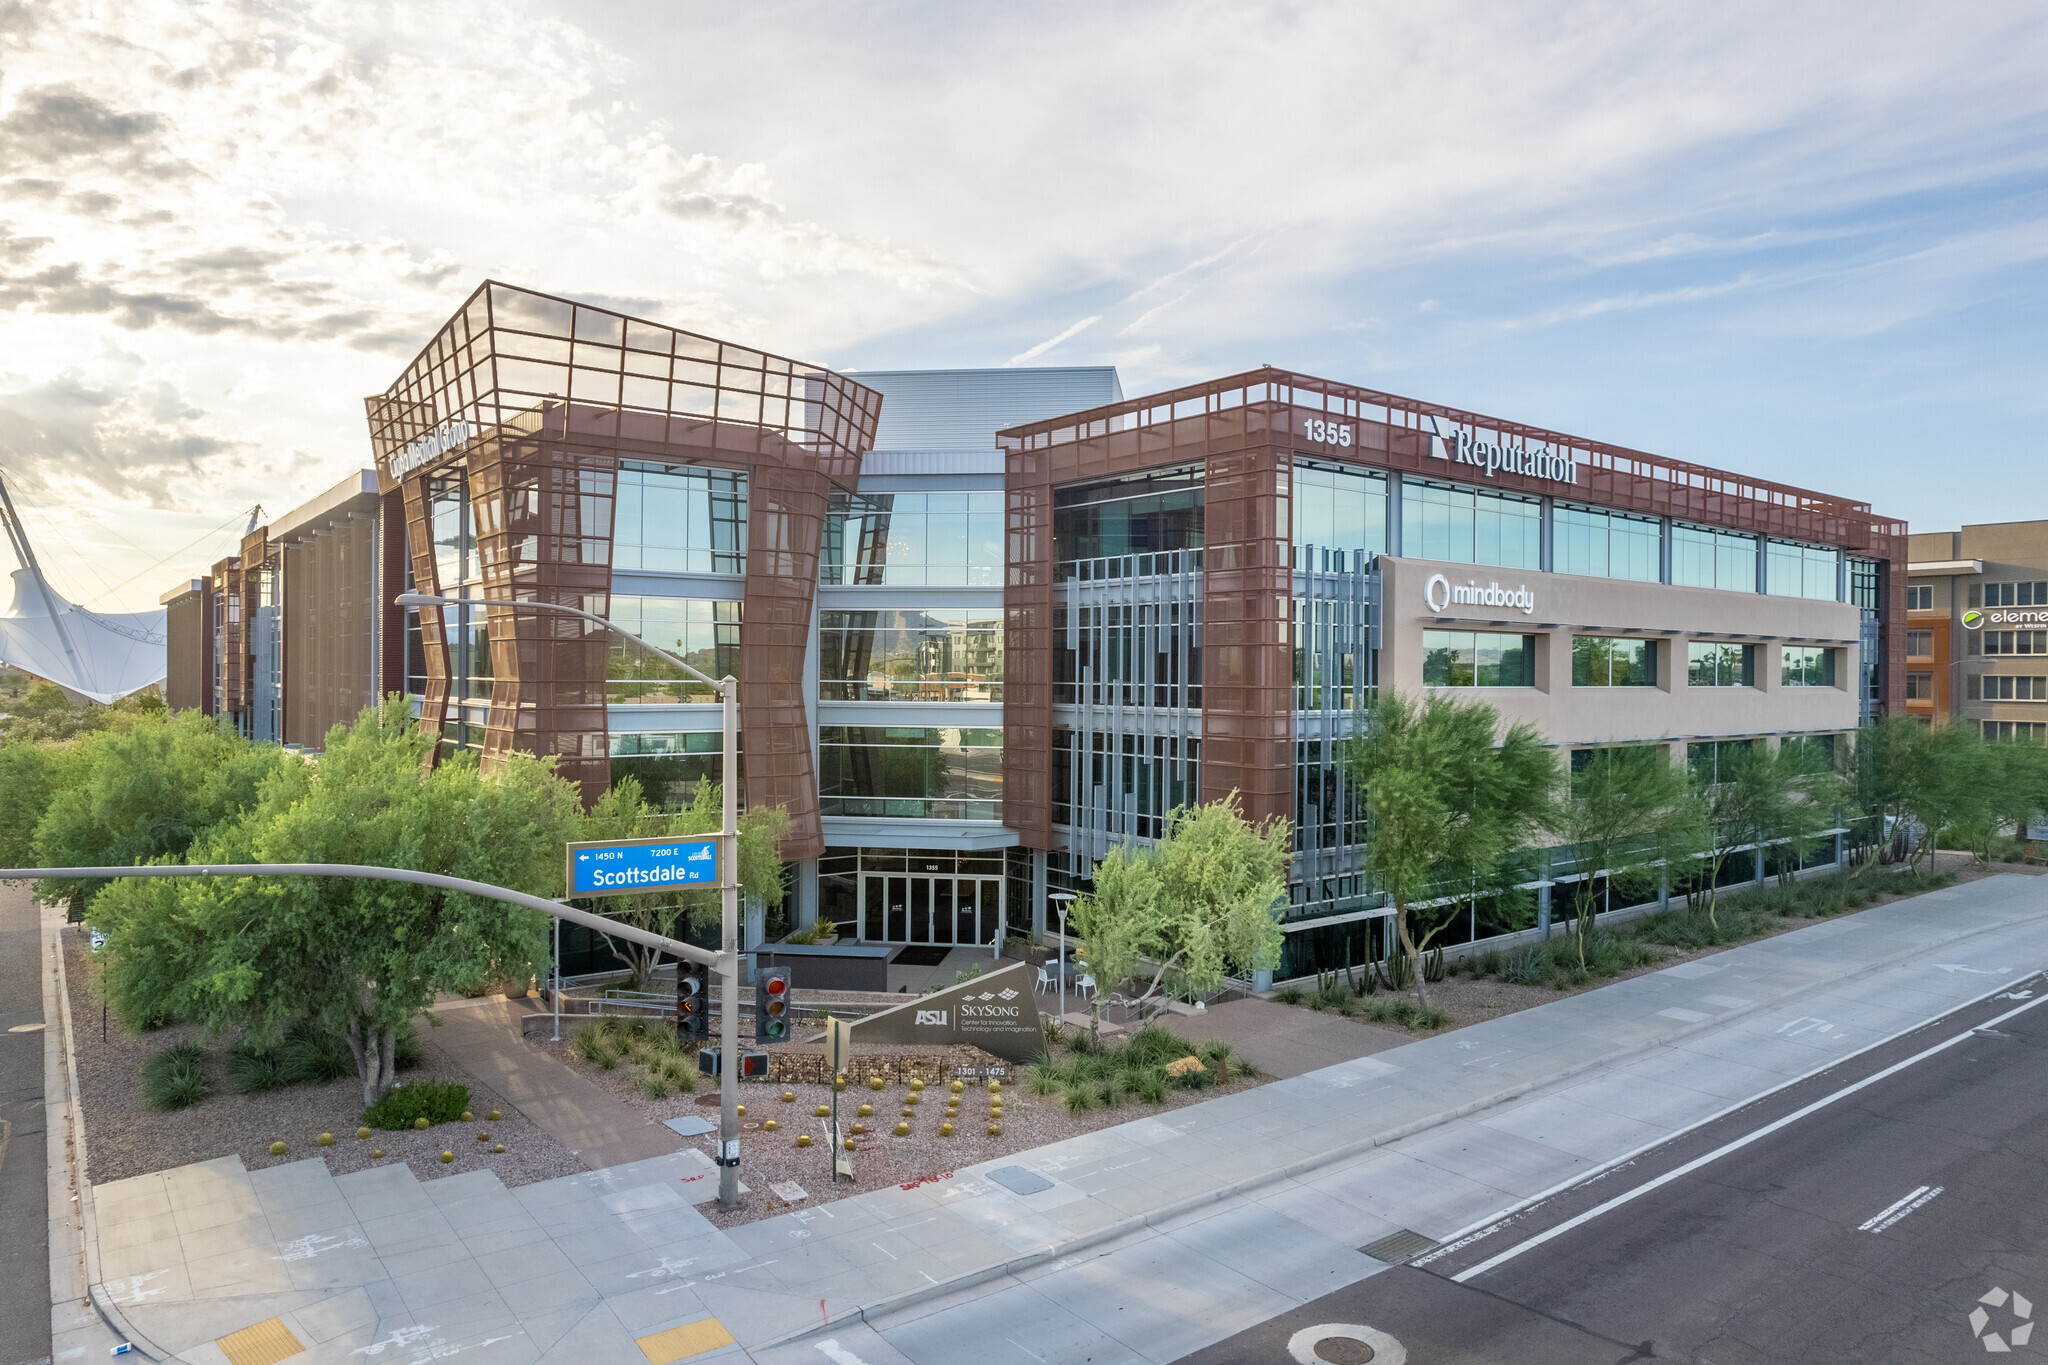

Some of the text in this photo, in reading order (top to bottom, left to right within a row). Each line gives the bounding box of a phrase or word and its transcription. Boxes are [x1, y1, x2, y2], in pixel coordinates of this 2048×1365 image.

[1304, 418, 1351, 447] 1355
[407, 426, 442, 470] Medical
[439, 419, 470, 452] Group
[1454, 427, 1577, 485] Reputation
[1451, 579, 1534, 615] mindbody
[595, 848, 679, 861] 1450 N 7200 E
[593, 864, 699, 886] Scottsdale Rd
[915, 1010, 947, 1026] ASU
[961, 1025, 992, 1033] Technology
[957, 1067, 976, 1076] 1301
[985, 1067, 1005, 1076] 1475
